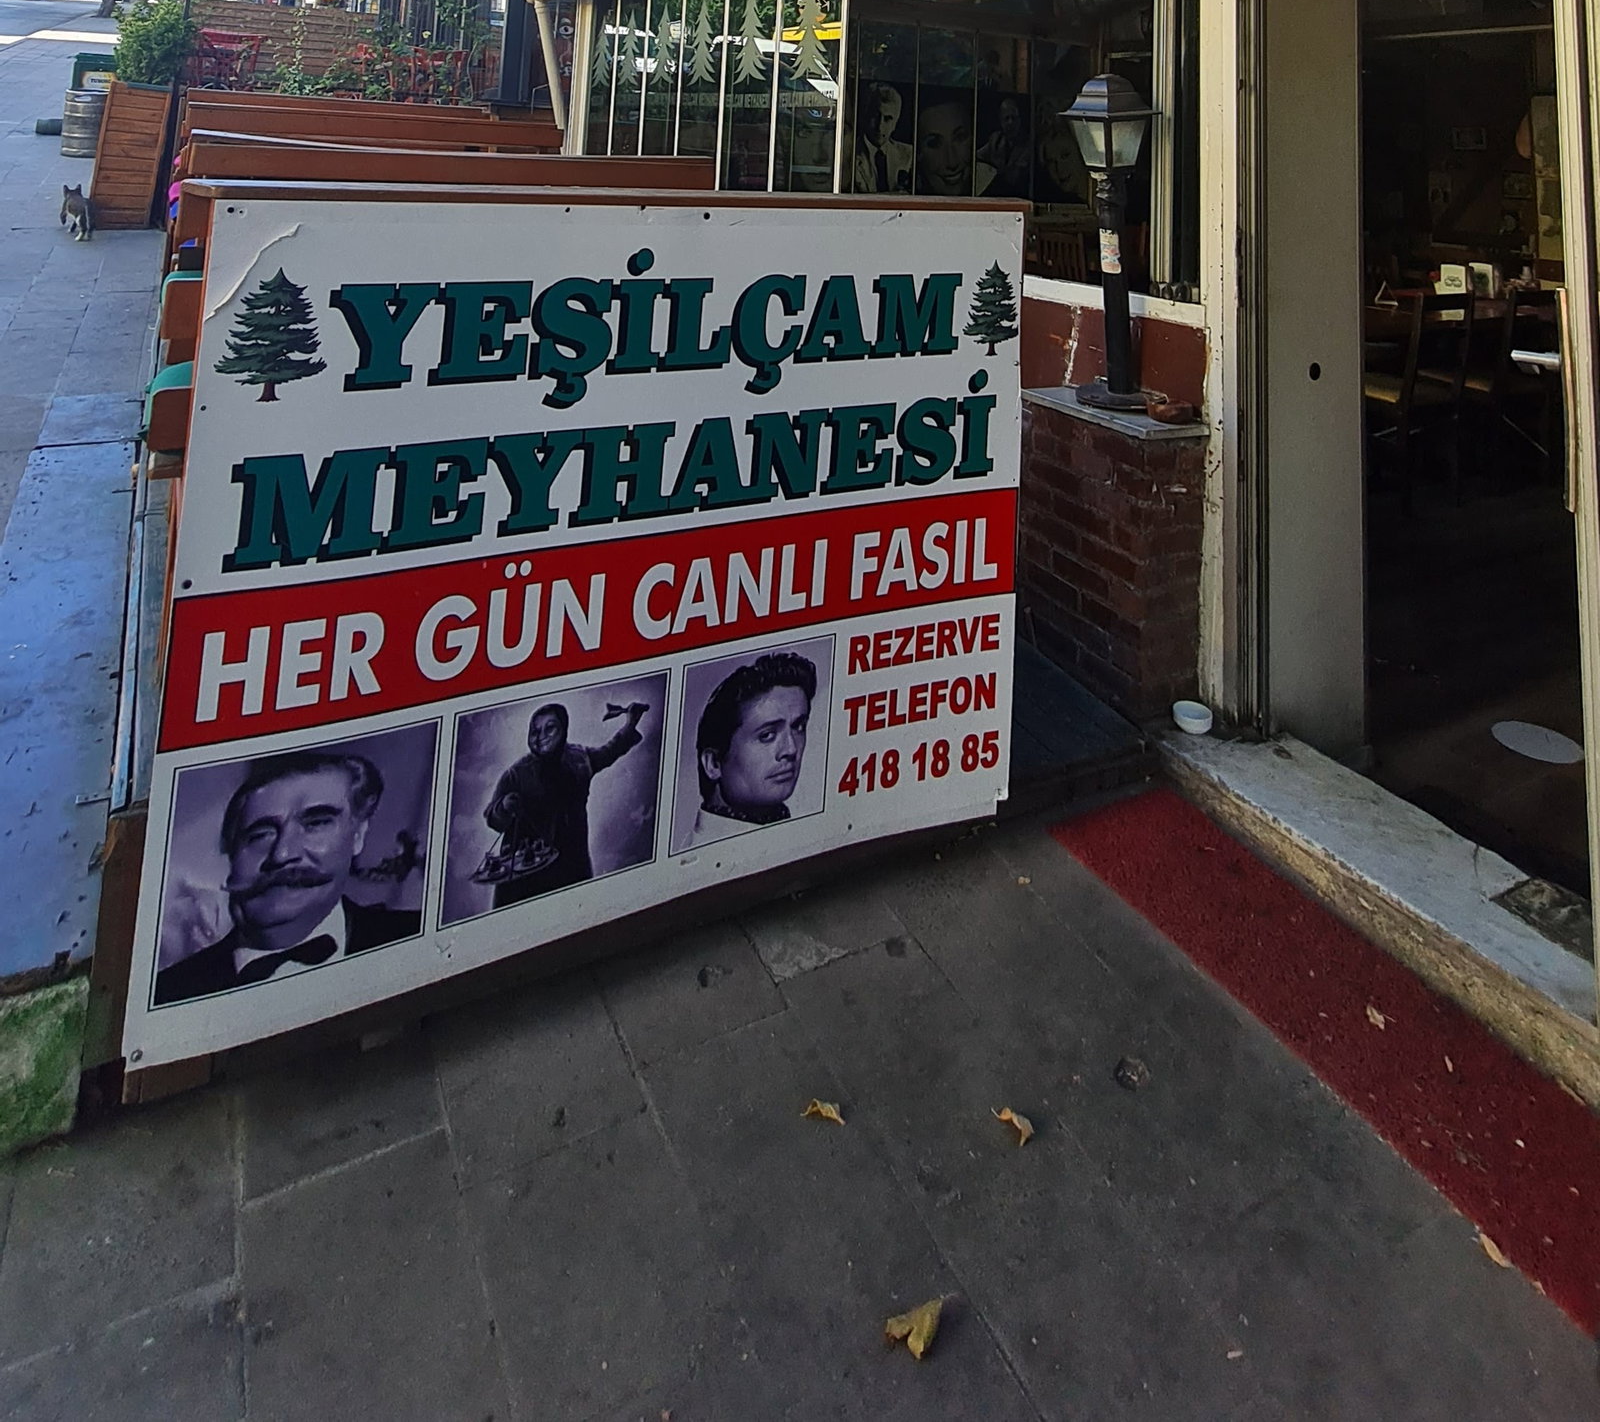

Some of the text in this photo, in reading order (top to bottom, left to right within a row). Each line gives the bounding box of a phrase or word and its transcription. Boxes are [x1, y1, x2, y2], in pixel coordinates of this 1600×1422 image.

[329, 248, 963, 409] YEŞİLÇAM
[221, 370, 997, 573] MEYHANESİ
[195, 517, 998, 724] HER GÜN CANLI FASIL
[848, 614, 1001, 676] REZERVE
[844, 672, 998, 736] TELEFON
[838, 729, 1000, 798] 418 18 85
